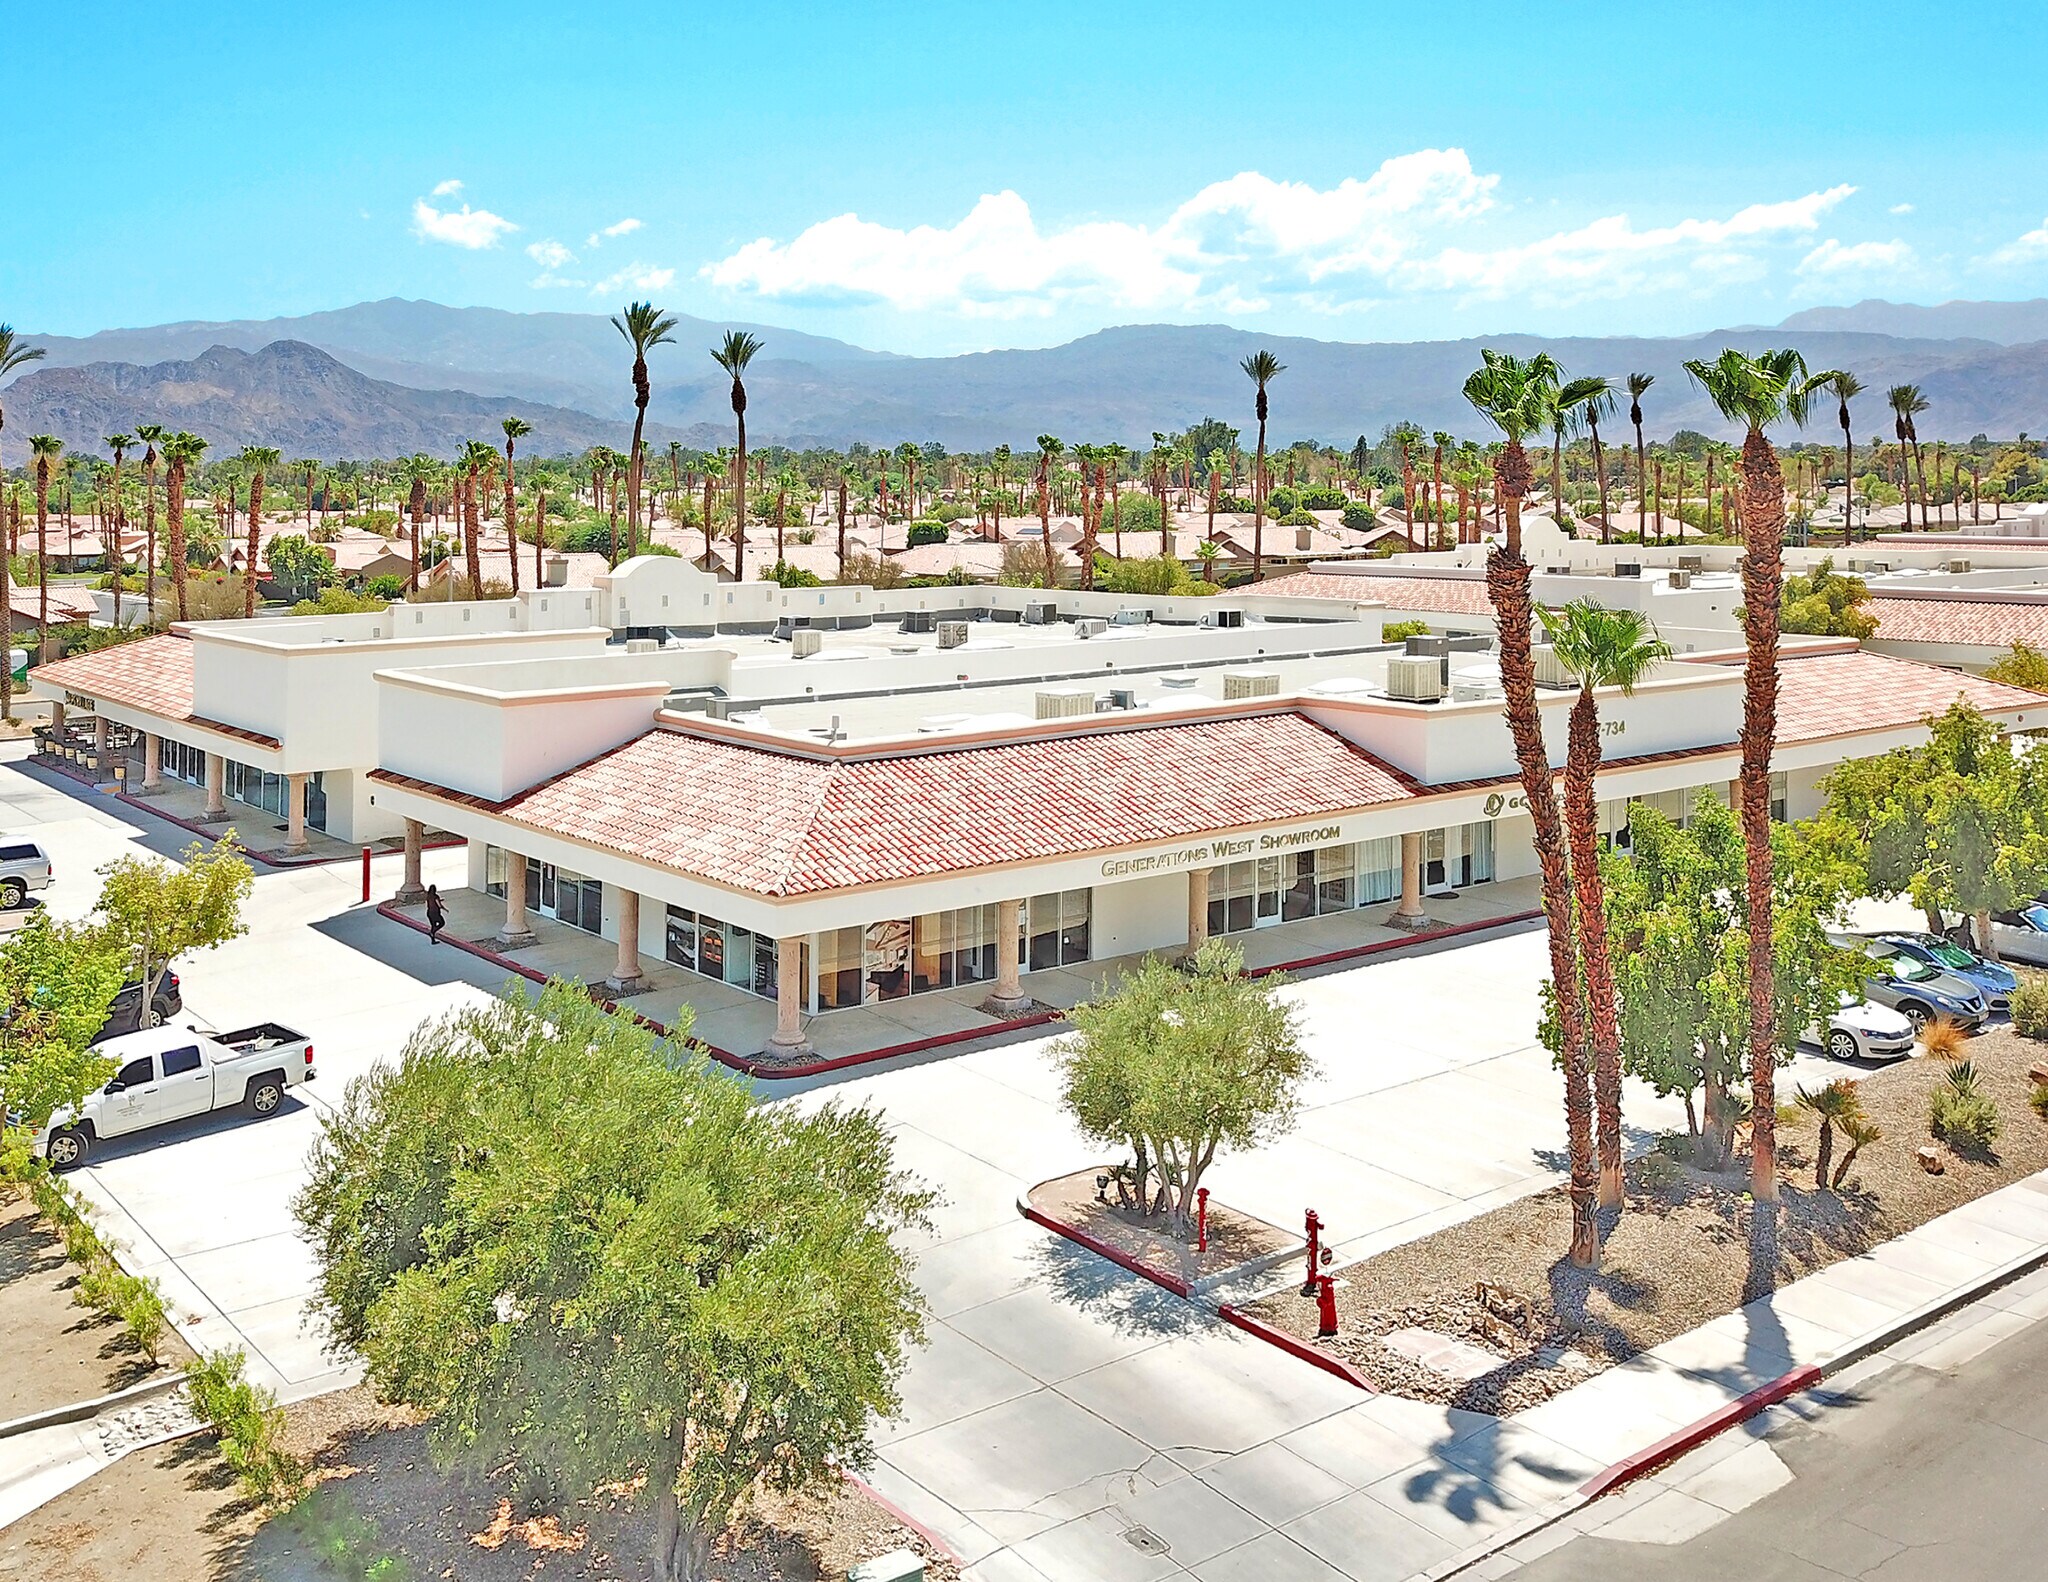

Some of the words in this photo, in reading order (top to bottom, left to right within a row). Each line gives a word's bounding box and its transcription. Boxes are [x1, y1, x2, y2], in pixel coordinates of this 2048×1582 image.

[1101, 847, 1208, 877] GENERATIONS
[1212, 839, 1255, 858] WEST
[1260, 825, 1341, 850] SHOWROOM
